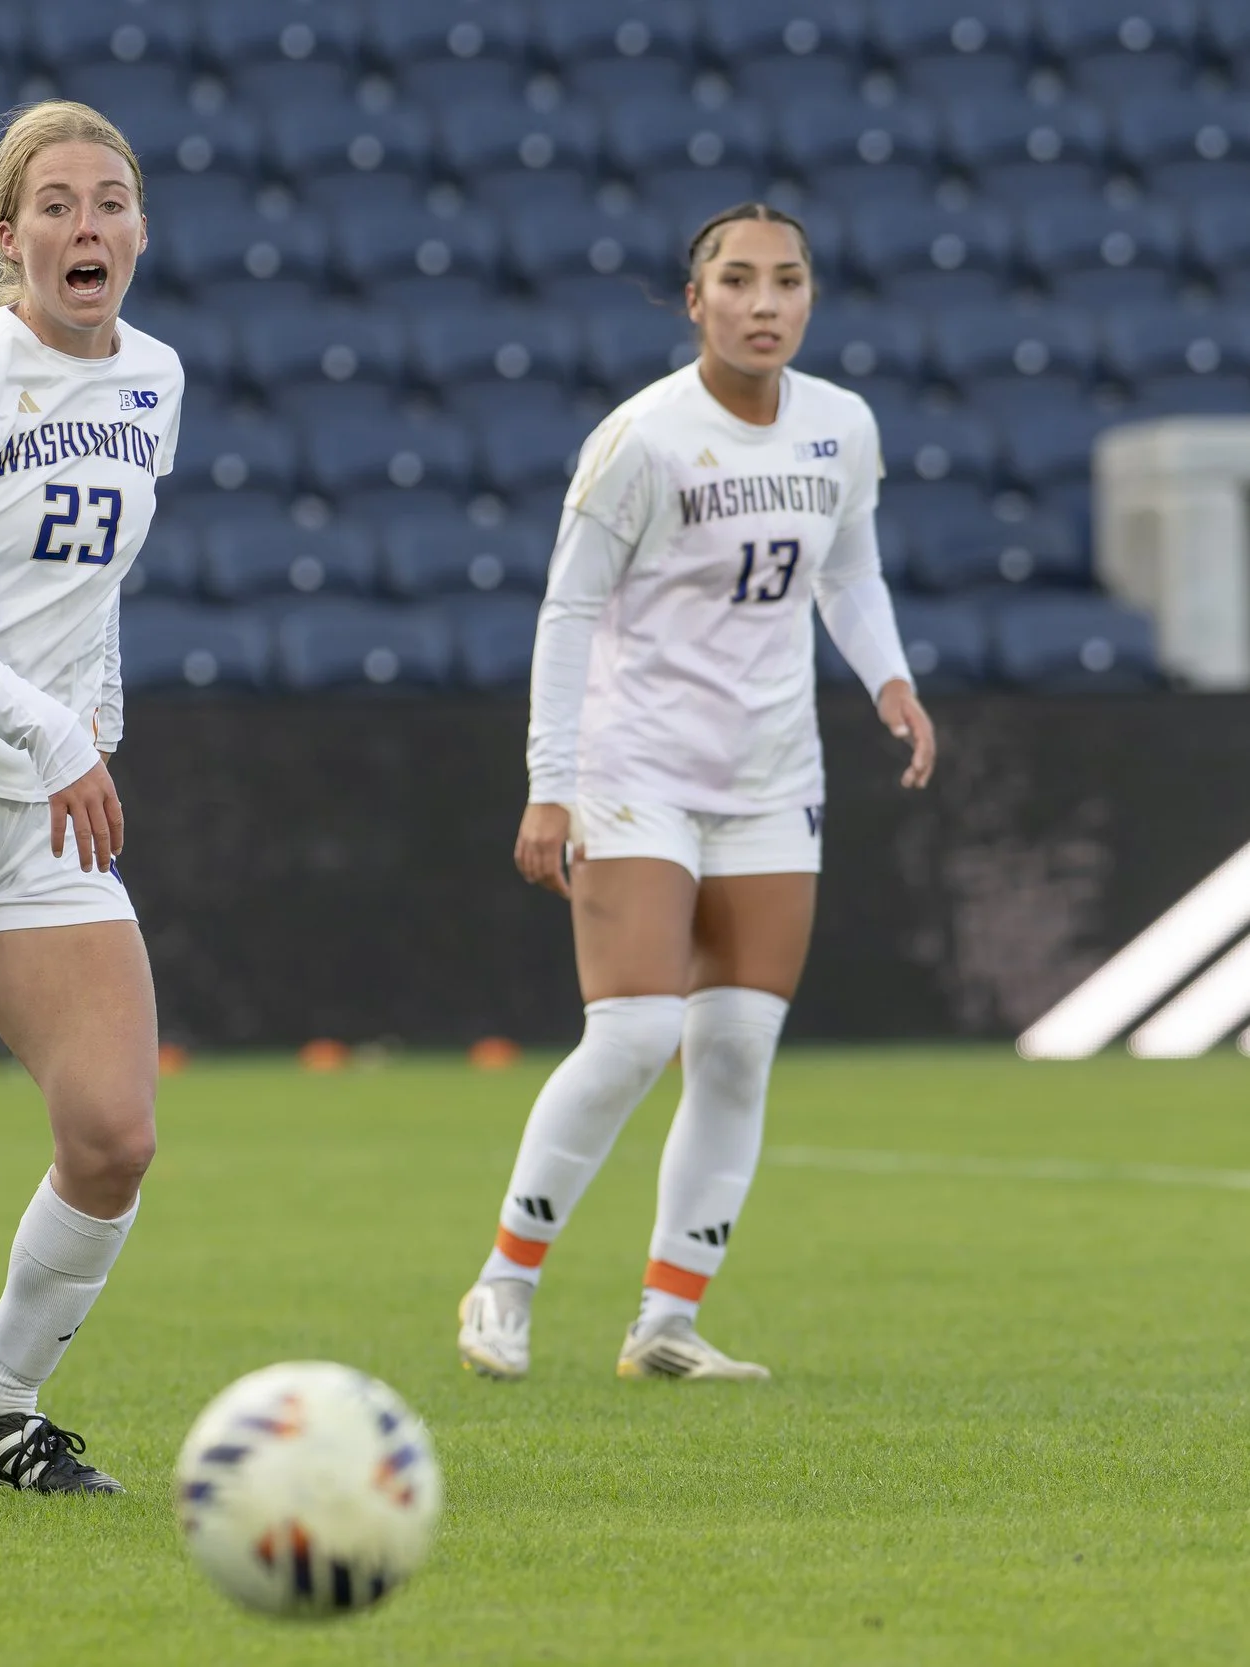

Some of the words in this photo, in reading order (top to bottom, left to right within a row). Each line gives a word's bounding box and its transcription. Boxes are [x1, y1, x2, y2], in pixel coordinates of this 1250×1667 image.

[30, 482, 123, 566] 23
[679, 474, 840, 526] WASHINGTON
[730, 538, 801, 605] 13
